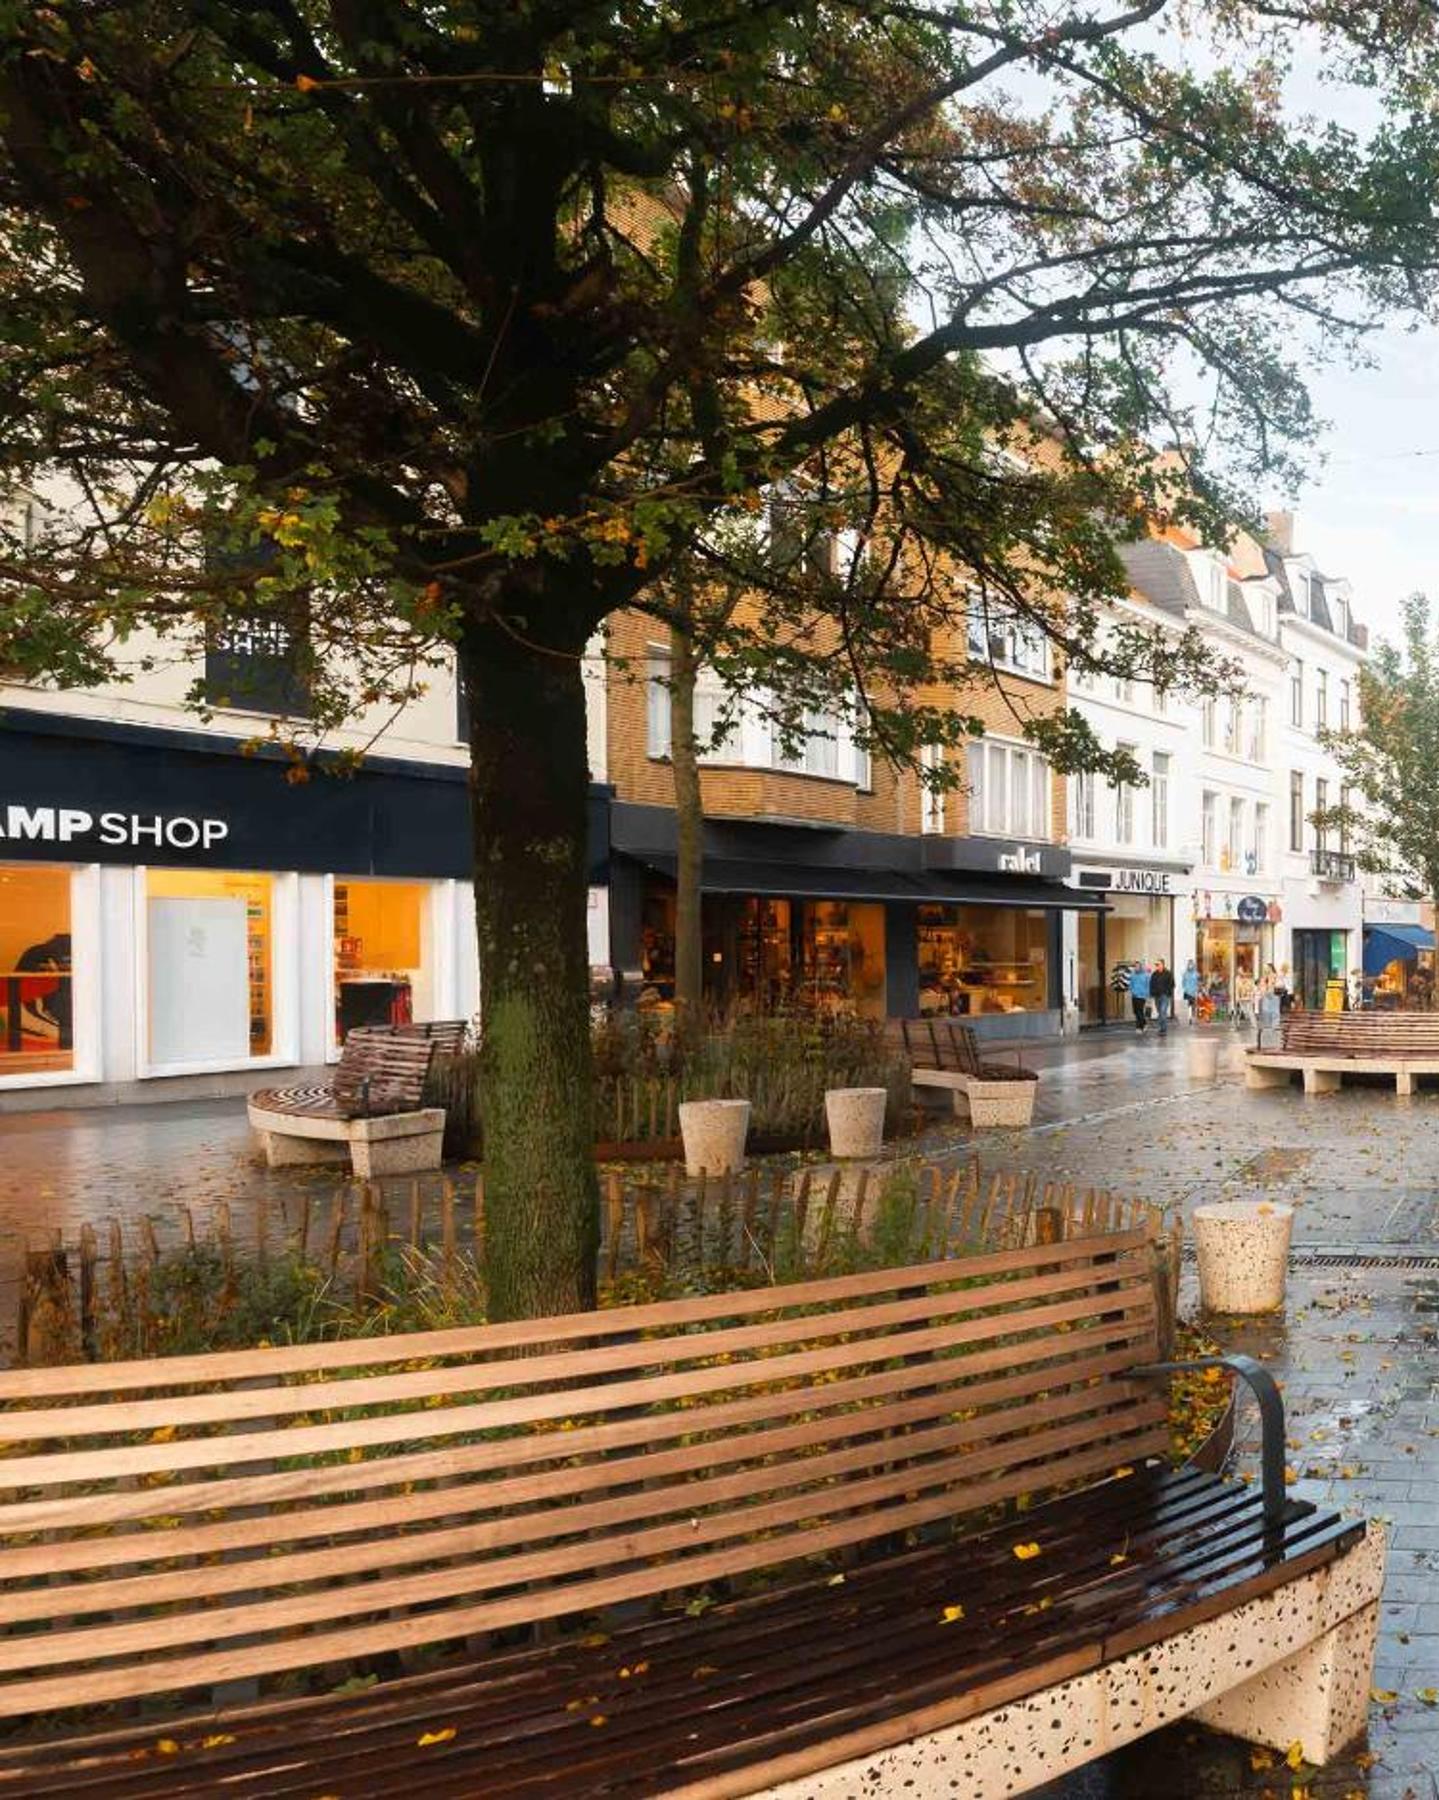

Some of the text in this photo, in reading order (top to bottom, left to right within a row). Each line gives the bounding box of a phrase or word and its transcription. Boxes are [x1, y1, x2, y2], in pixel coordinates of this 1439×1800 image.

[0, 805, 229, 849] MP SHOP
[1115, 871, 1171, 893] JUNIQUE
